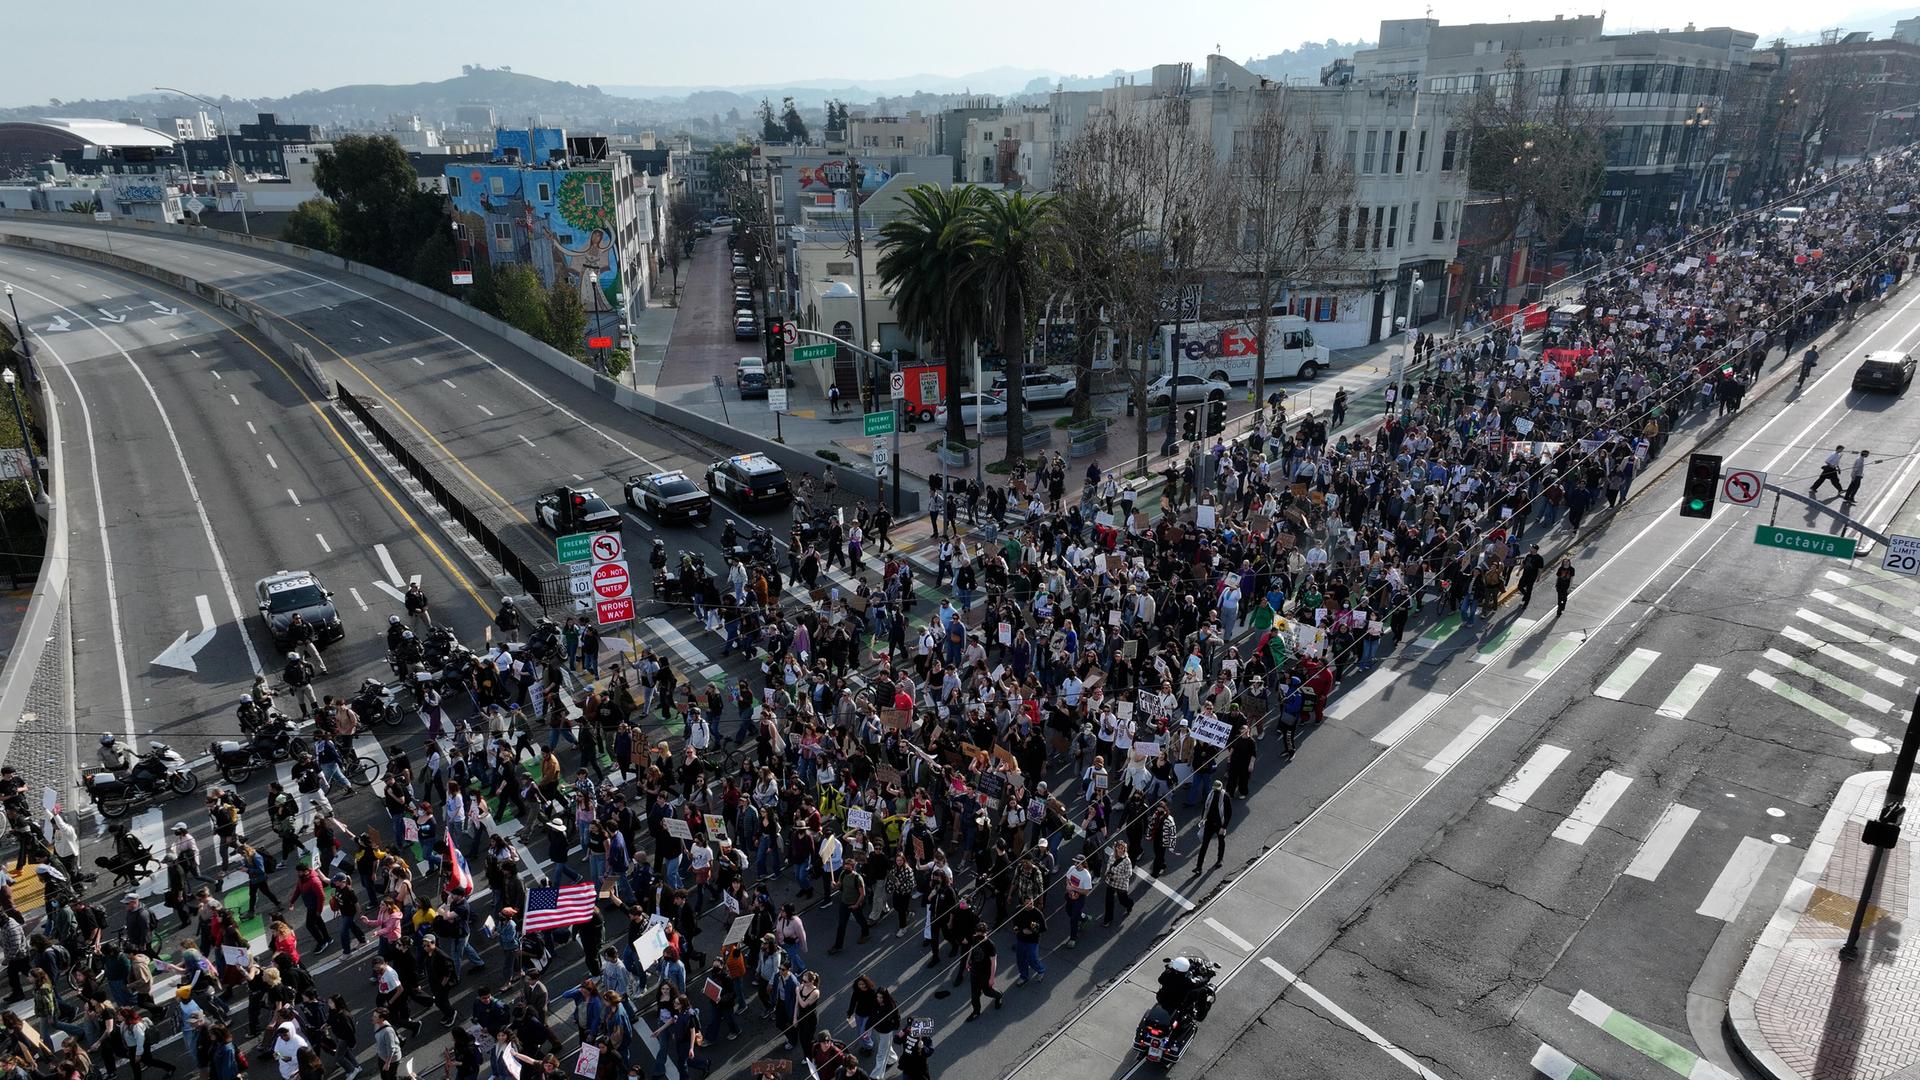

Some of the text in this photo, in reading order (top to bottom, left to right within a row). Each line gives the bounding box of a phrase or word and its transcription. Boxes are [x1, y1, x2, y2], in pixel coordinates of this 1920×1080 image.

[1171, 327, 1259, 361] FedEx
[802, 347, 827, 359] Market
[867, 424, 891, 432] ENTRANCE
[875, 452, 886, 462] 101
[563, 538, 591, 548] FREEWAY
[1774, 532, 1835, 552] Octavia
[1891, 538, 1920, 549] SPEED
[562, 547, 591, 558] ENTRANC
[1893, 546, 1917, 556] LIMIT
[571, 563, 589, 573] SOUTH
[1886, 555, 1915, 570] 20
[597, 568, 623, 579] DO NOT
[574, 581, 590, 592] 101
[601, 584, 623, 594] ENTER
[600, 600, 629, 612] WRONG
[607, 610, 625, 620] WAY
[1195, 715, 1226, 733] Migration
[1196, 725, 1215, 740] human
